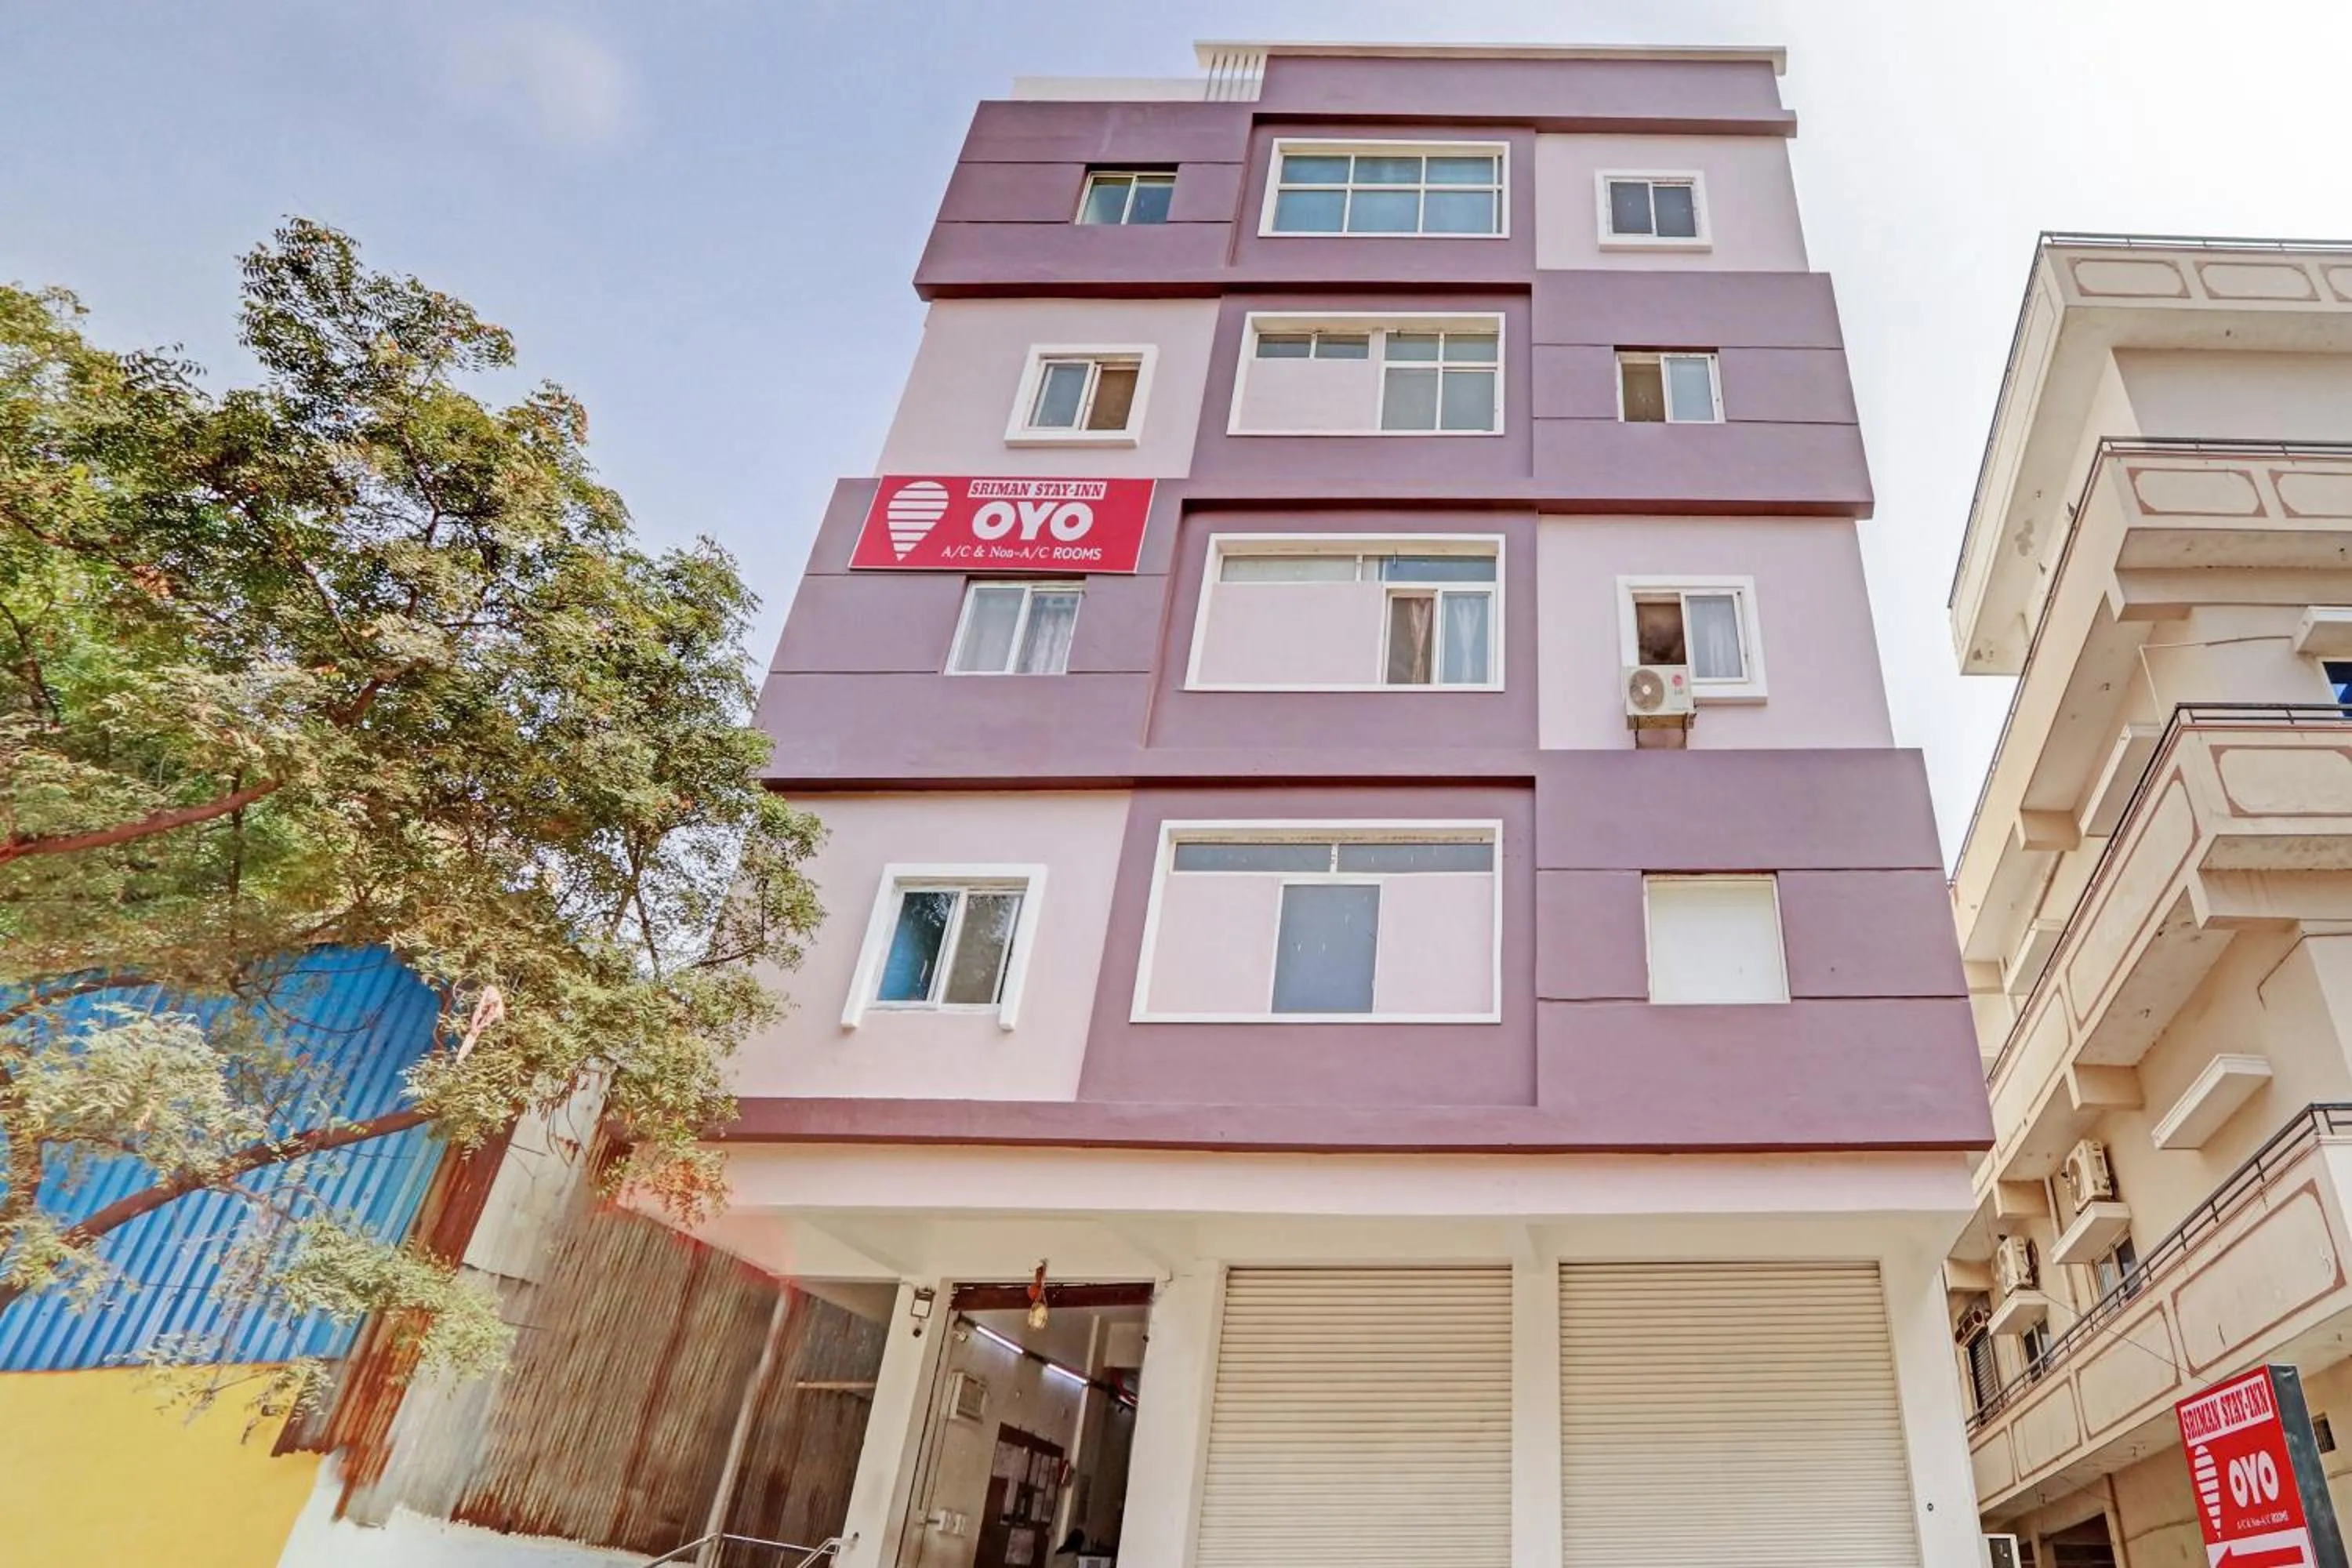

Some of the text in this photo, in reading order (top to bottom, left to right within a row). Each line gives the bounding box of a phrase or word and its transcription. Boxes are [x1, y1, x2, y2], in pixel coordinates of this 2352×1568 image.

[971, 482, 1102, 497] SRIMAN STAY-INN
[972, 501, 1094, 541] OYO
[941, 545, 1102, 561] A/C & Non-A/C ROOMS
[2220, 1381, 2269, 1427] STAY-INN
[2229, 1450, 2279, 1508] OYO
